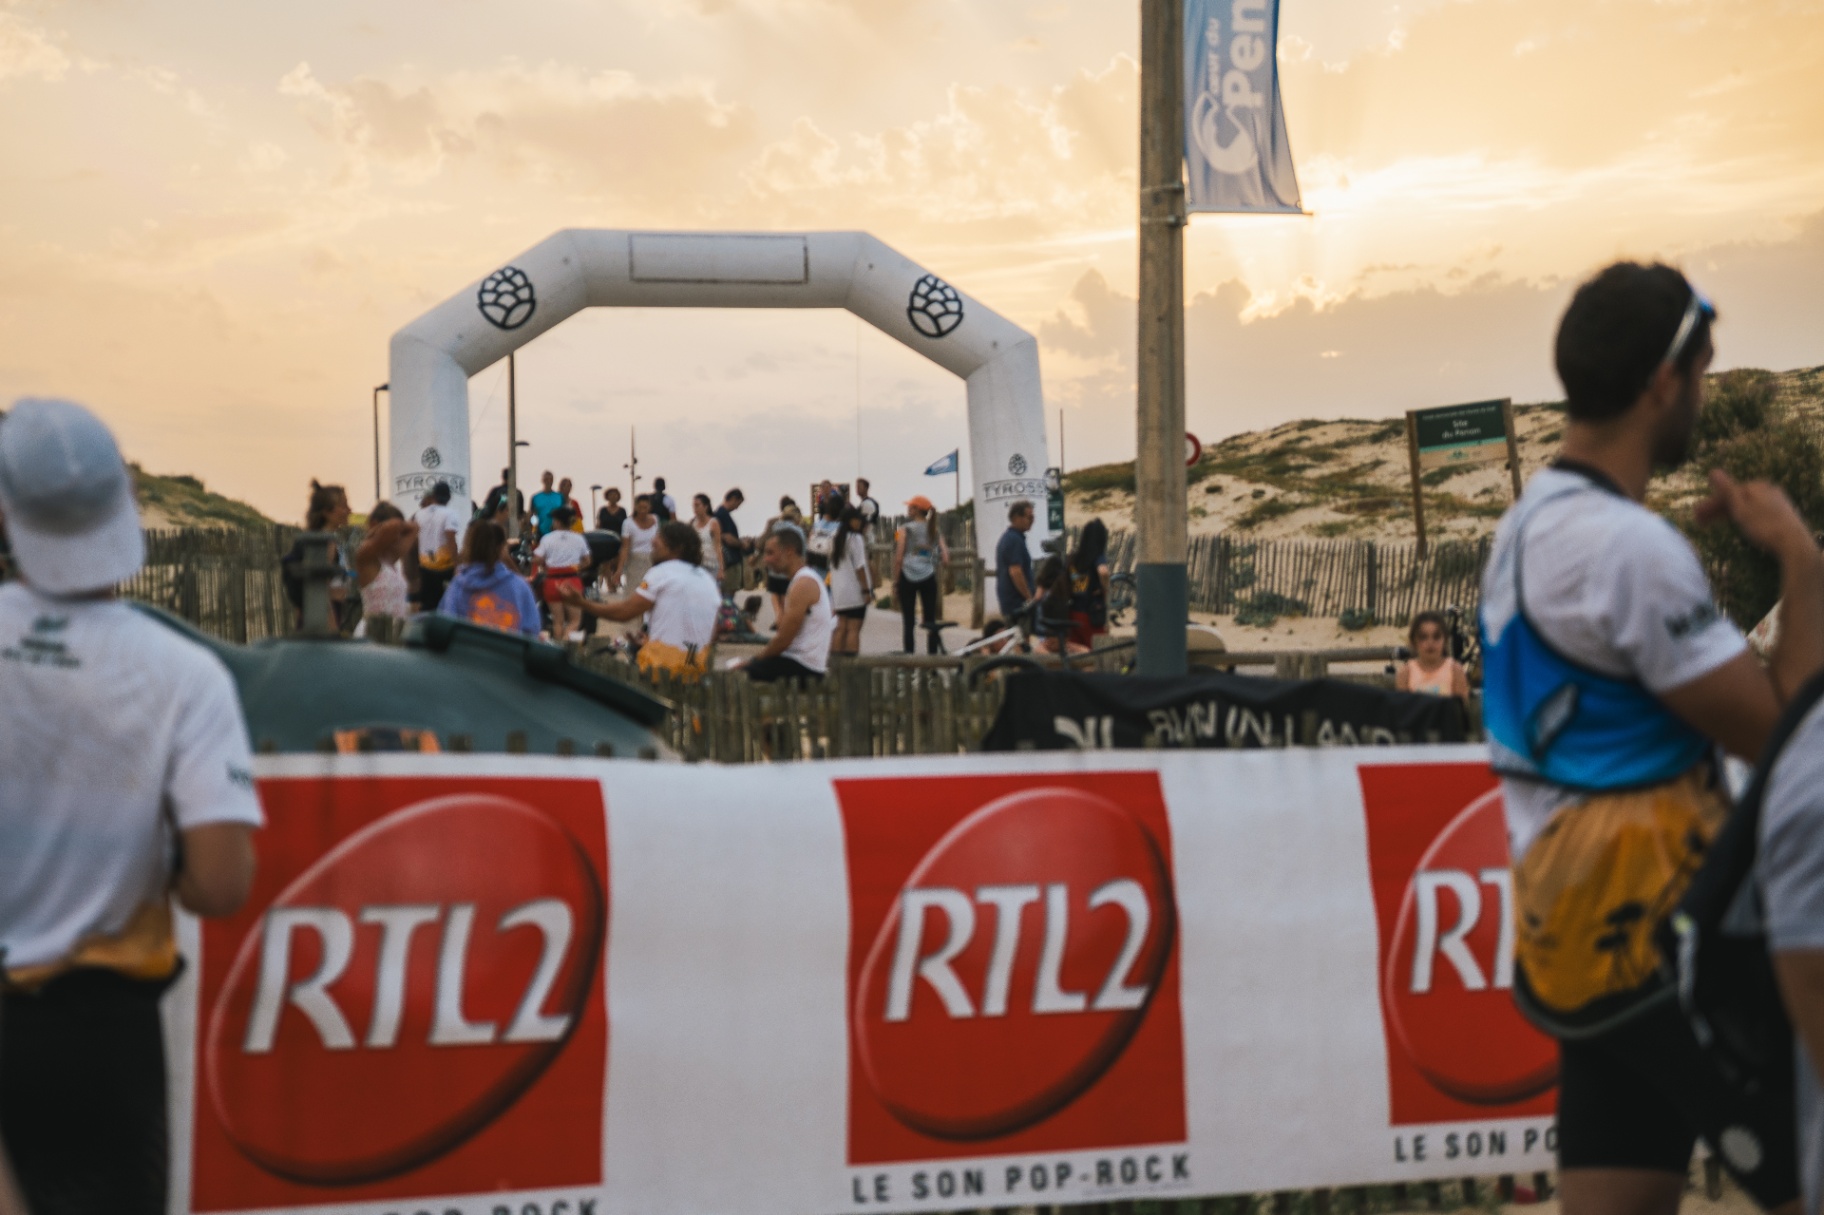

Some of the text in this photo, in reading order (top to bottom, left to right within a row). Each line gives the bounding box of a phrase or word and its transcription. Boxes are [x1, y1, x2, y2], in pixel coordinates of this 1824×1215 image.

[1225, 704, 1272, 747] IN
[884, 877, 1151, 1022] RTL2
[1409, 868, 1514, 994] RT
[242, 897, 575, 1054] RTL2
[853, 1153, 1190, 1204] LE SON POP-ROCK
[1395, 1134, 1427, 1162] LE
[1445, 1129, 1506, 1159] SON
